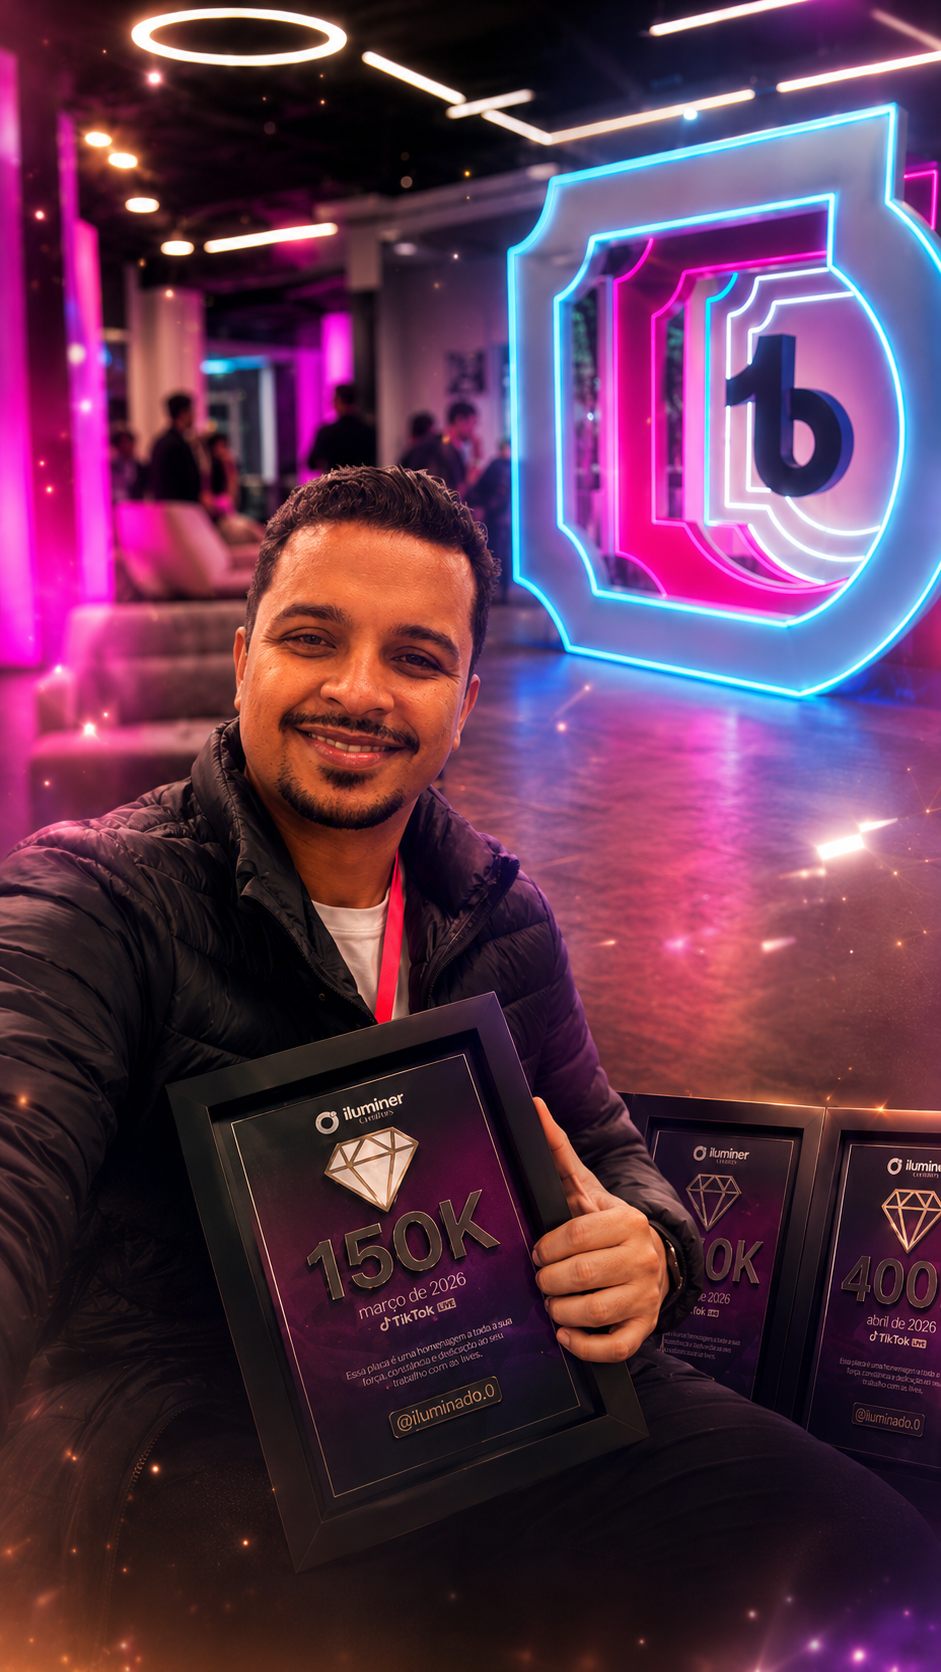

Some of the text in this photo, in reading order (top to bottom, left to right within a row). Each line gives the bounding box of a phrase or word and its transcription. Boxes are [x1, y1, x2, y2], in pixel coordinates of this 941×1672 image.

[342, 1093, 404, 1121] iluminer
[709, 1147, 750, 1160] iluminer
[905, 1159, 941, 1173] ilumin
[306, 1189, 501, 1300] 150K
[700, 1237, 764, 1284] 0K
[841, 1255, 940, 1308] 400
[358, 1271, 467, 1320] março de 2026
[707, 1291, 731, 1304] 2026
[392, 1305, 435, 1328] TikTok
[866, 1314, 937, 1334] abril de 2026
[345, 1368, 367, 1380] Essa
[391, 1355, 397, 1364] é
[397, 1351, 417, 1362] uma
[498, 1317, 513, 1328] sua
[879, 1332, 910, 1346] TikTok
[428, 1362, 448, 1374] com
[397, 1383, 495, 1431] @iluminado.0
[855, 1407, 921, 1432] @iluminado.0
